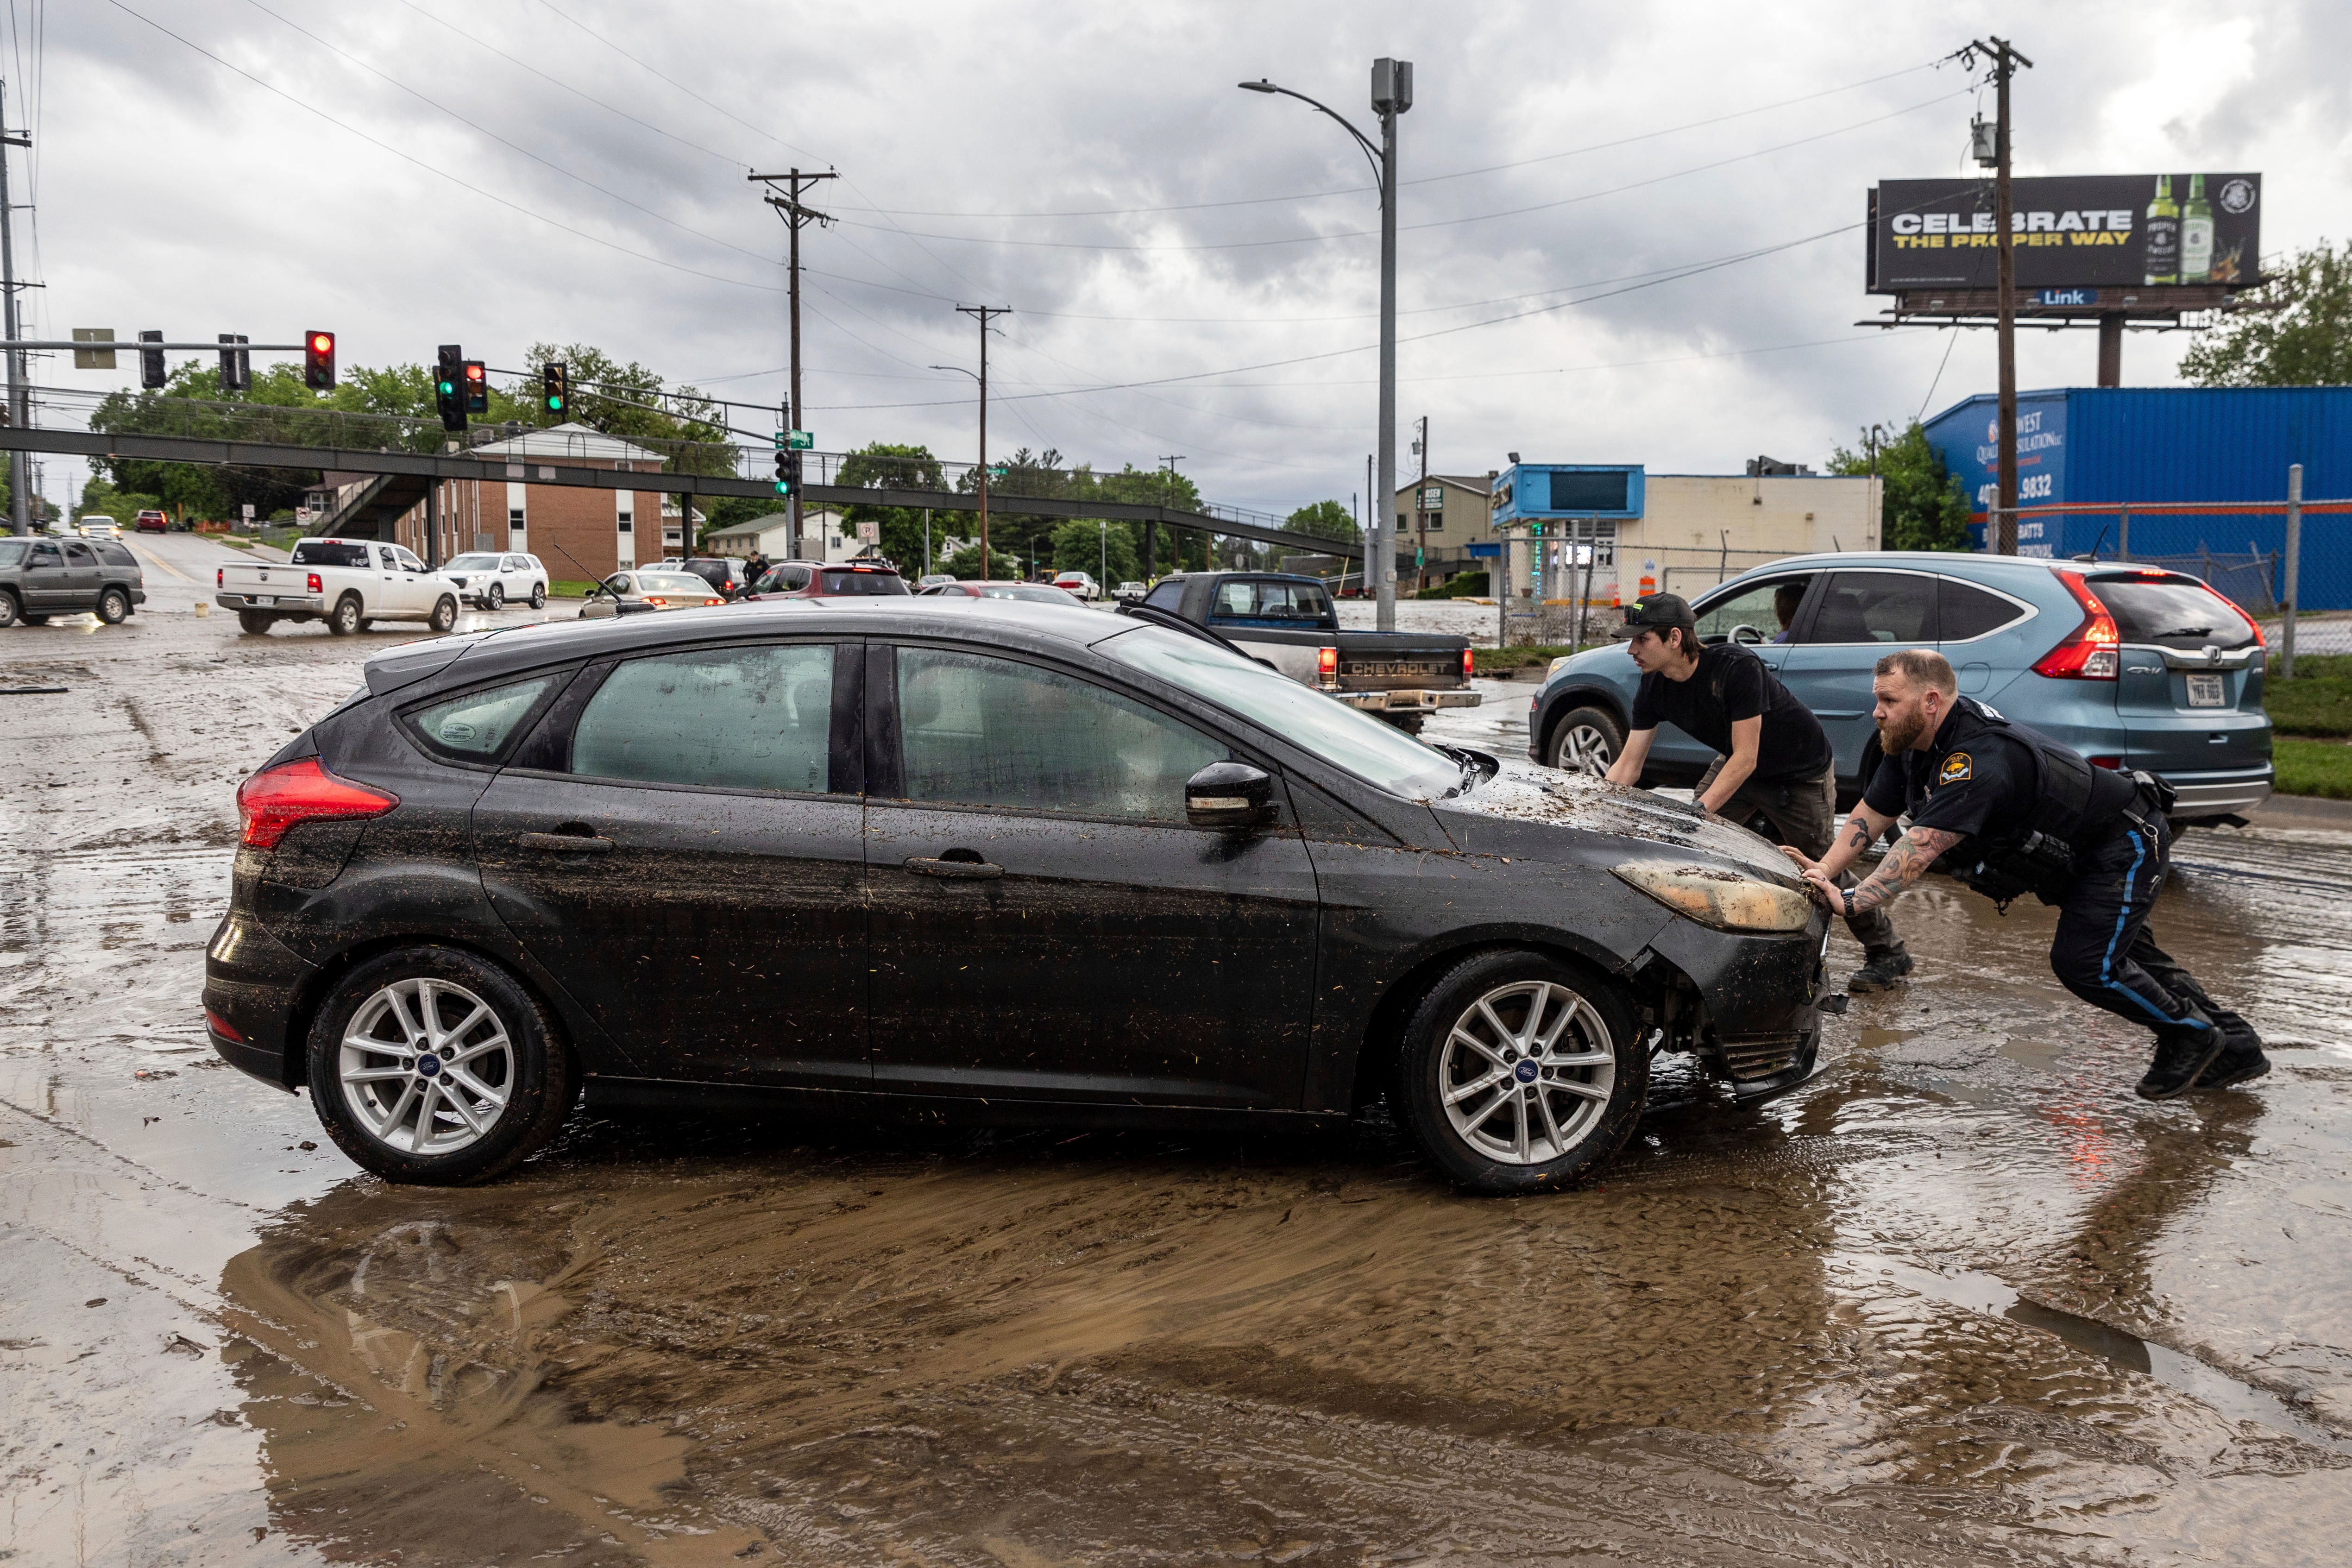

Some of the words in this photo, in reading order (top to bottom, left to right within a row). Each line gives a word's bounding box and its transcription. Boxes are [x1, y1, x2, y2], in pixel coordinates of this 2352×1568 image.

[1892, 210, 2133, 234] CELEBRATE
[1893, 235, 1945, 249] THE
[2069, 231, 2131, 246] WAY
[2045, 289, 2084, 305] Link
[2016, 411, 2042, 434] WEST
[1352, 663, 1447, 674] CHEVROLET
[1521, 1067, 1533, 1076] Ford
